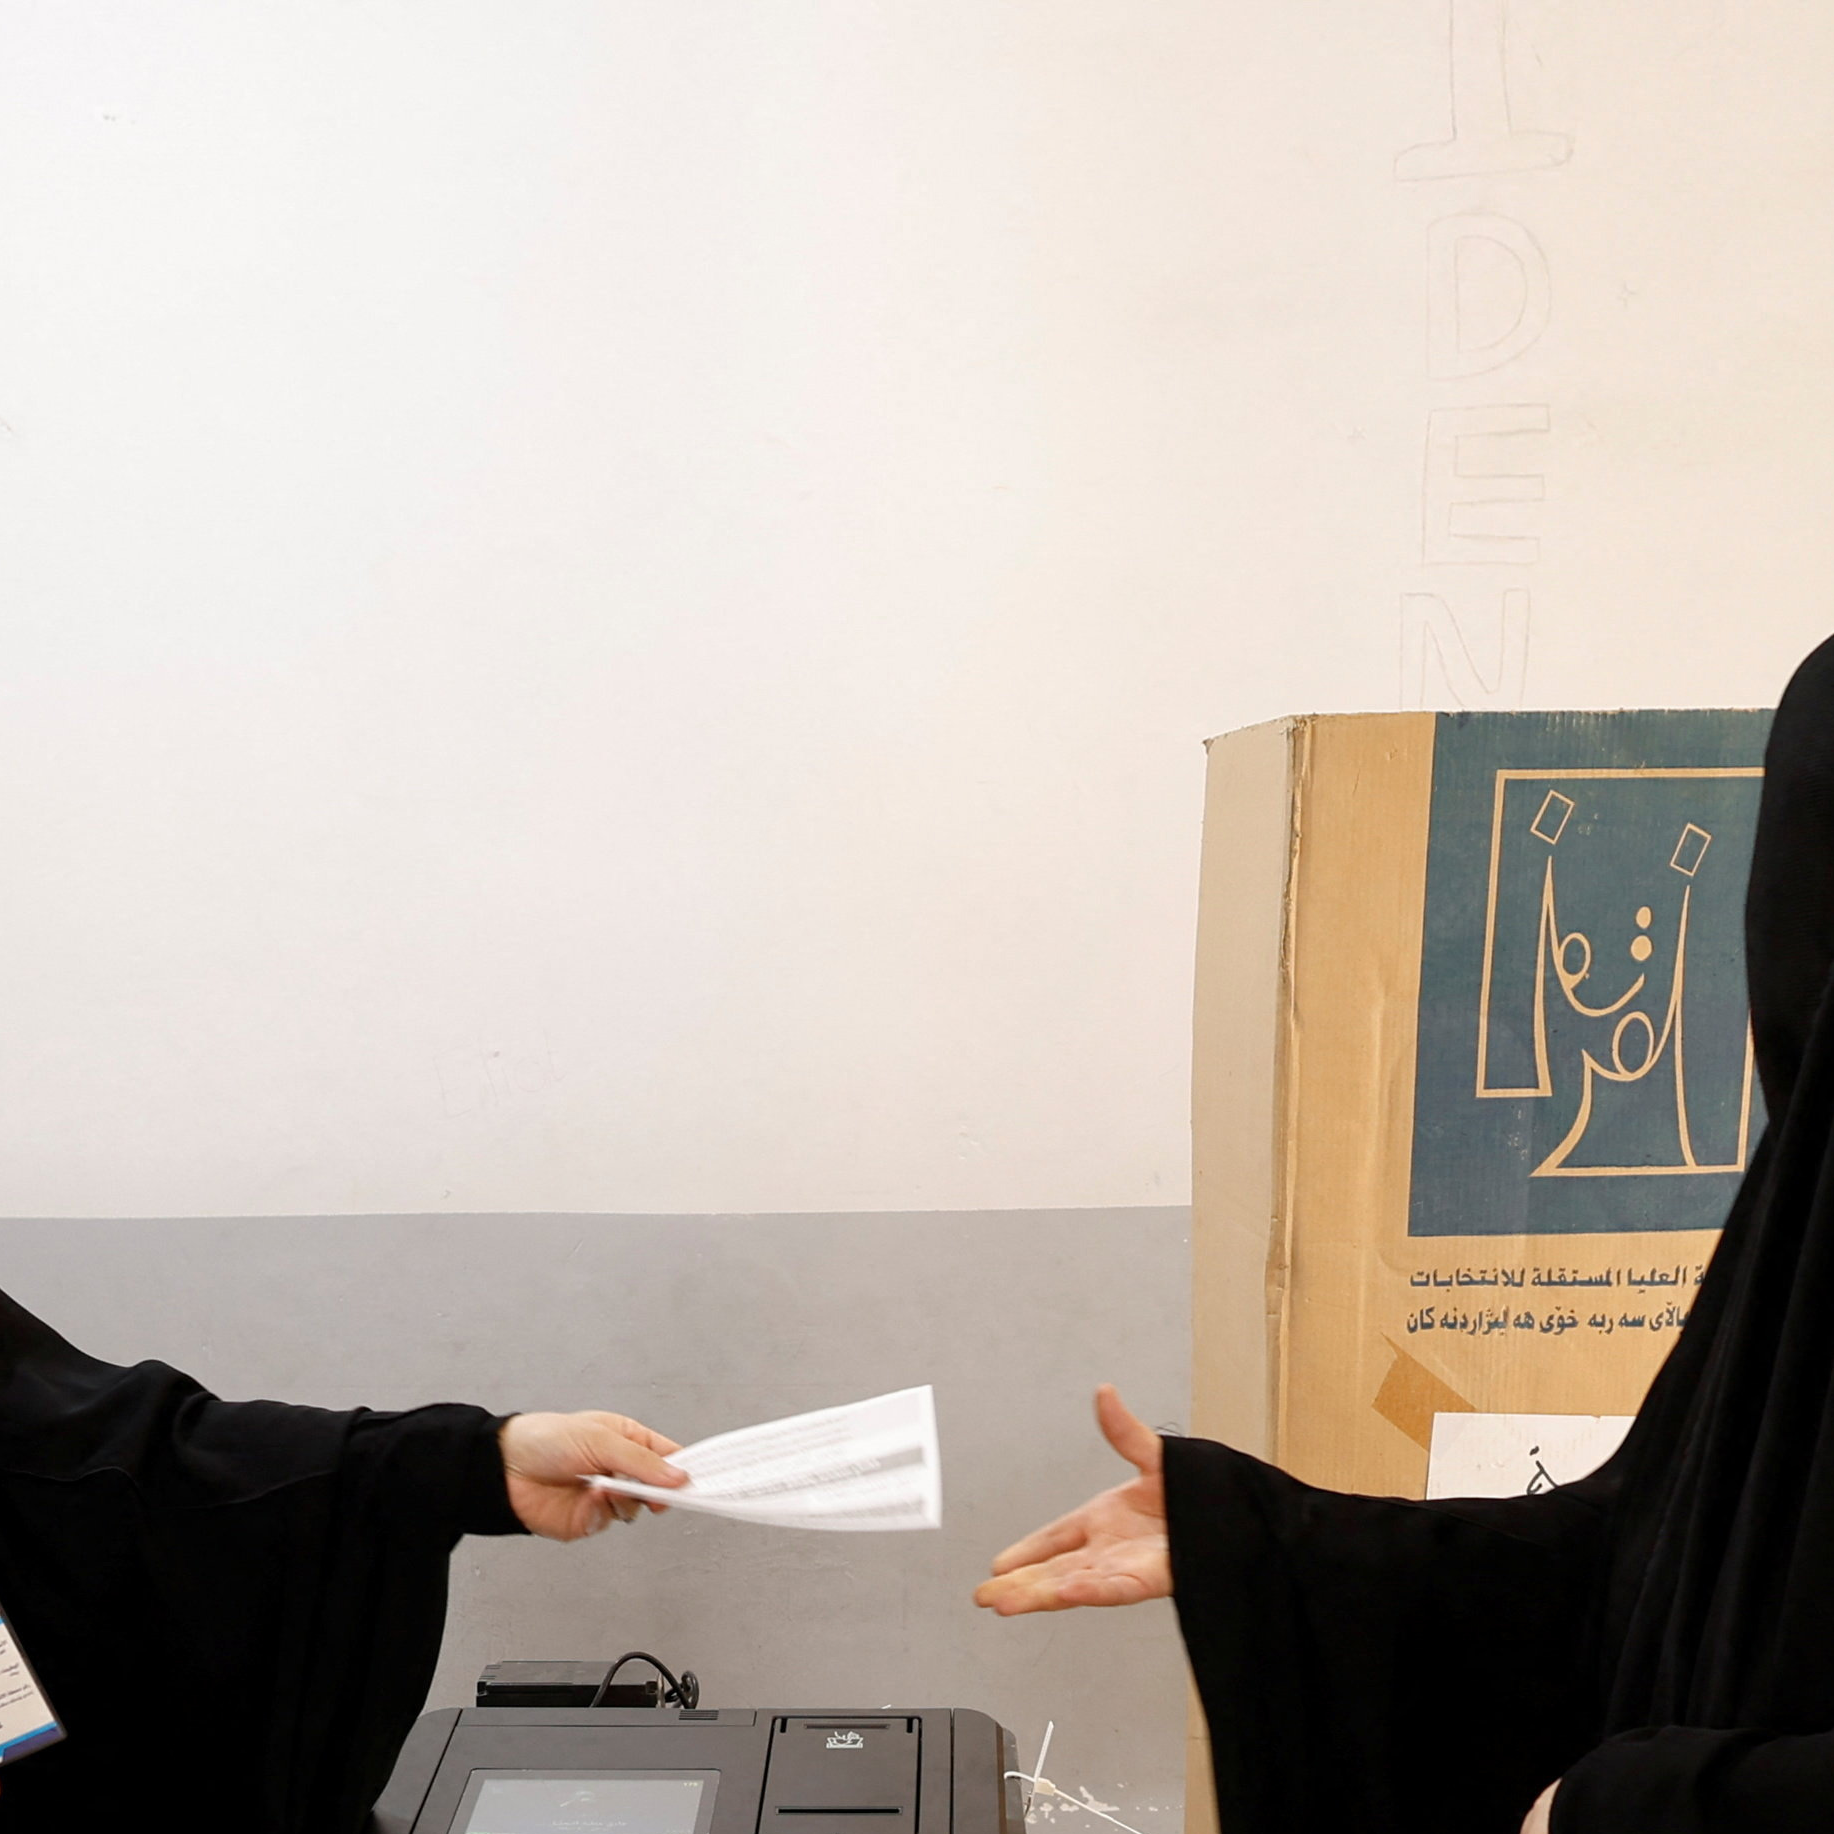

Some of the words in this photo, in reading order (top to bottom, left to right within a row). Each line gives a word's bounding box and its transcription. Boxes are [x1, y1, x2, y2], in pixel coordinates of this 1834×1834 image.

[1409, 1265, 1526, 1293] للانتخابات
[1531, 1265, 1621, 1288] المستقلة
[1627, 1264, 1687, 1294] العليا
